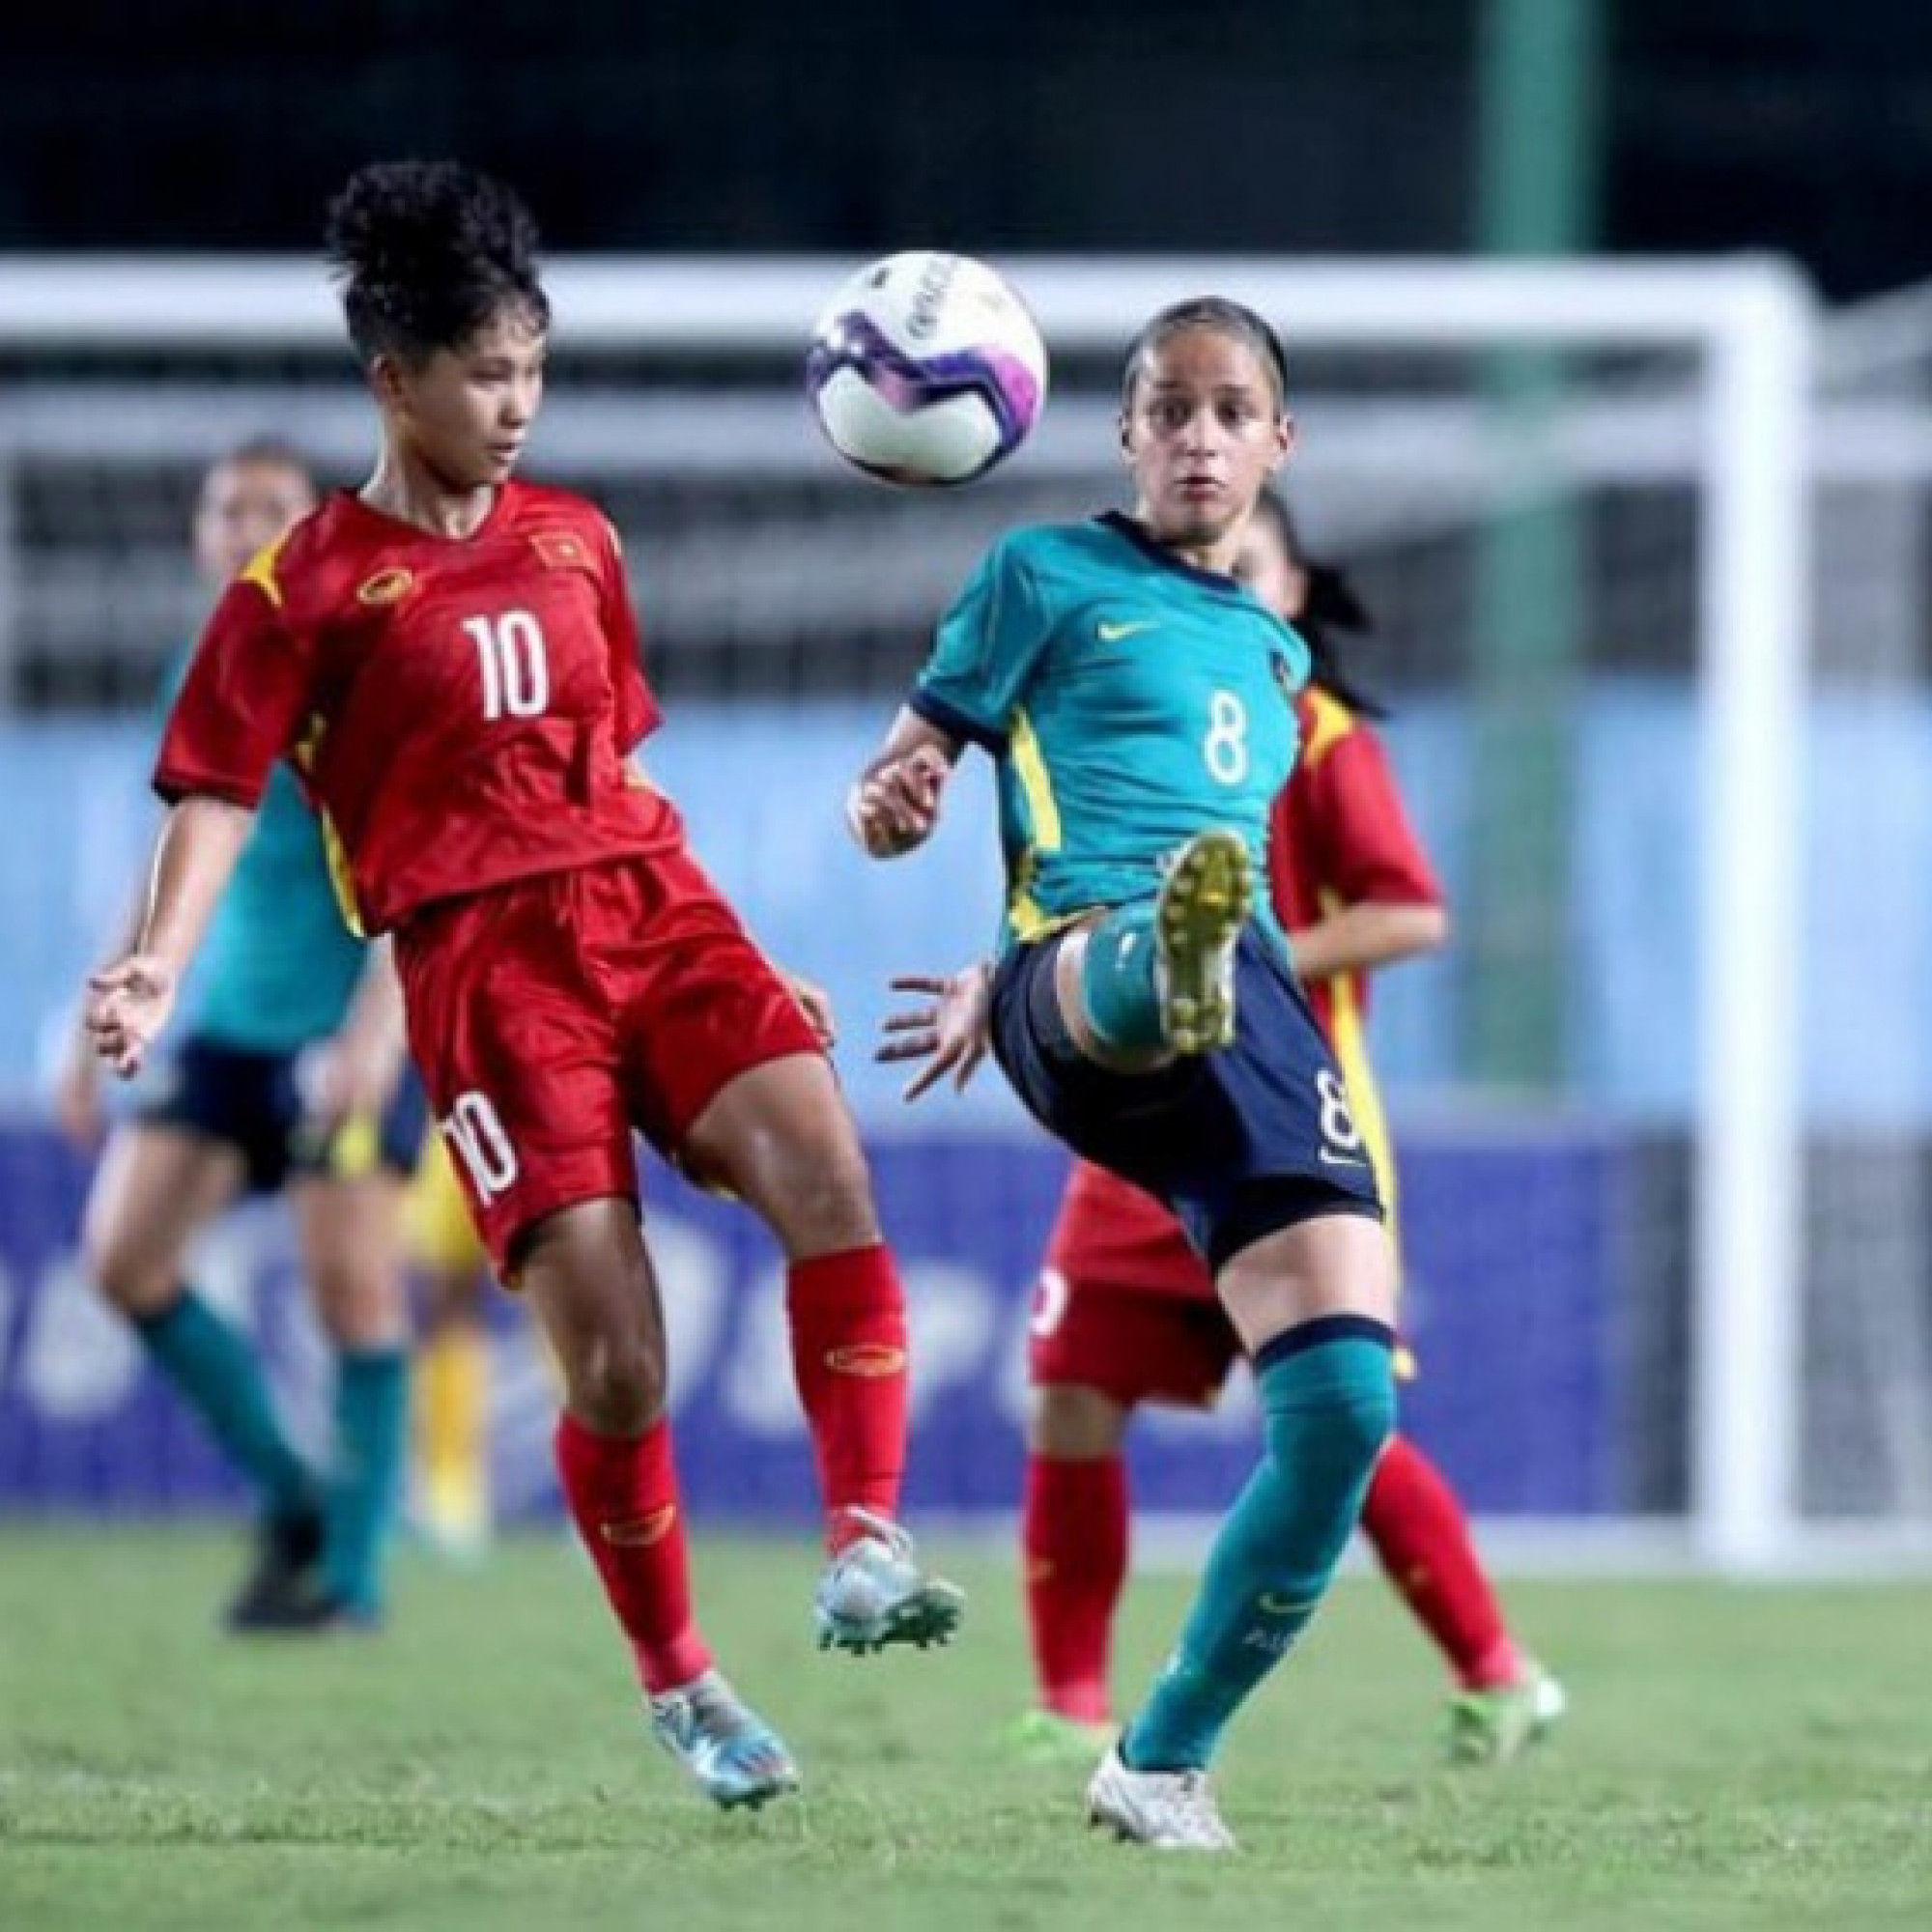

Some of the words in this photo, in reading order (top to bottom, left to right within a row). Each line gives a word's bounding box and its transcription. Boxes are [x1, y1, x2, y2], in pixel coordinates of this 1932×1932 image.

[461, 610, 549, 721] 10
[1205, 689, 1247, 785] 8
[440, 1092, 518, 1207] 10
[1317, 1068, 1357, 1149] 8
